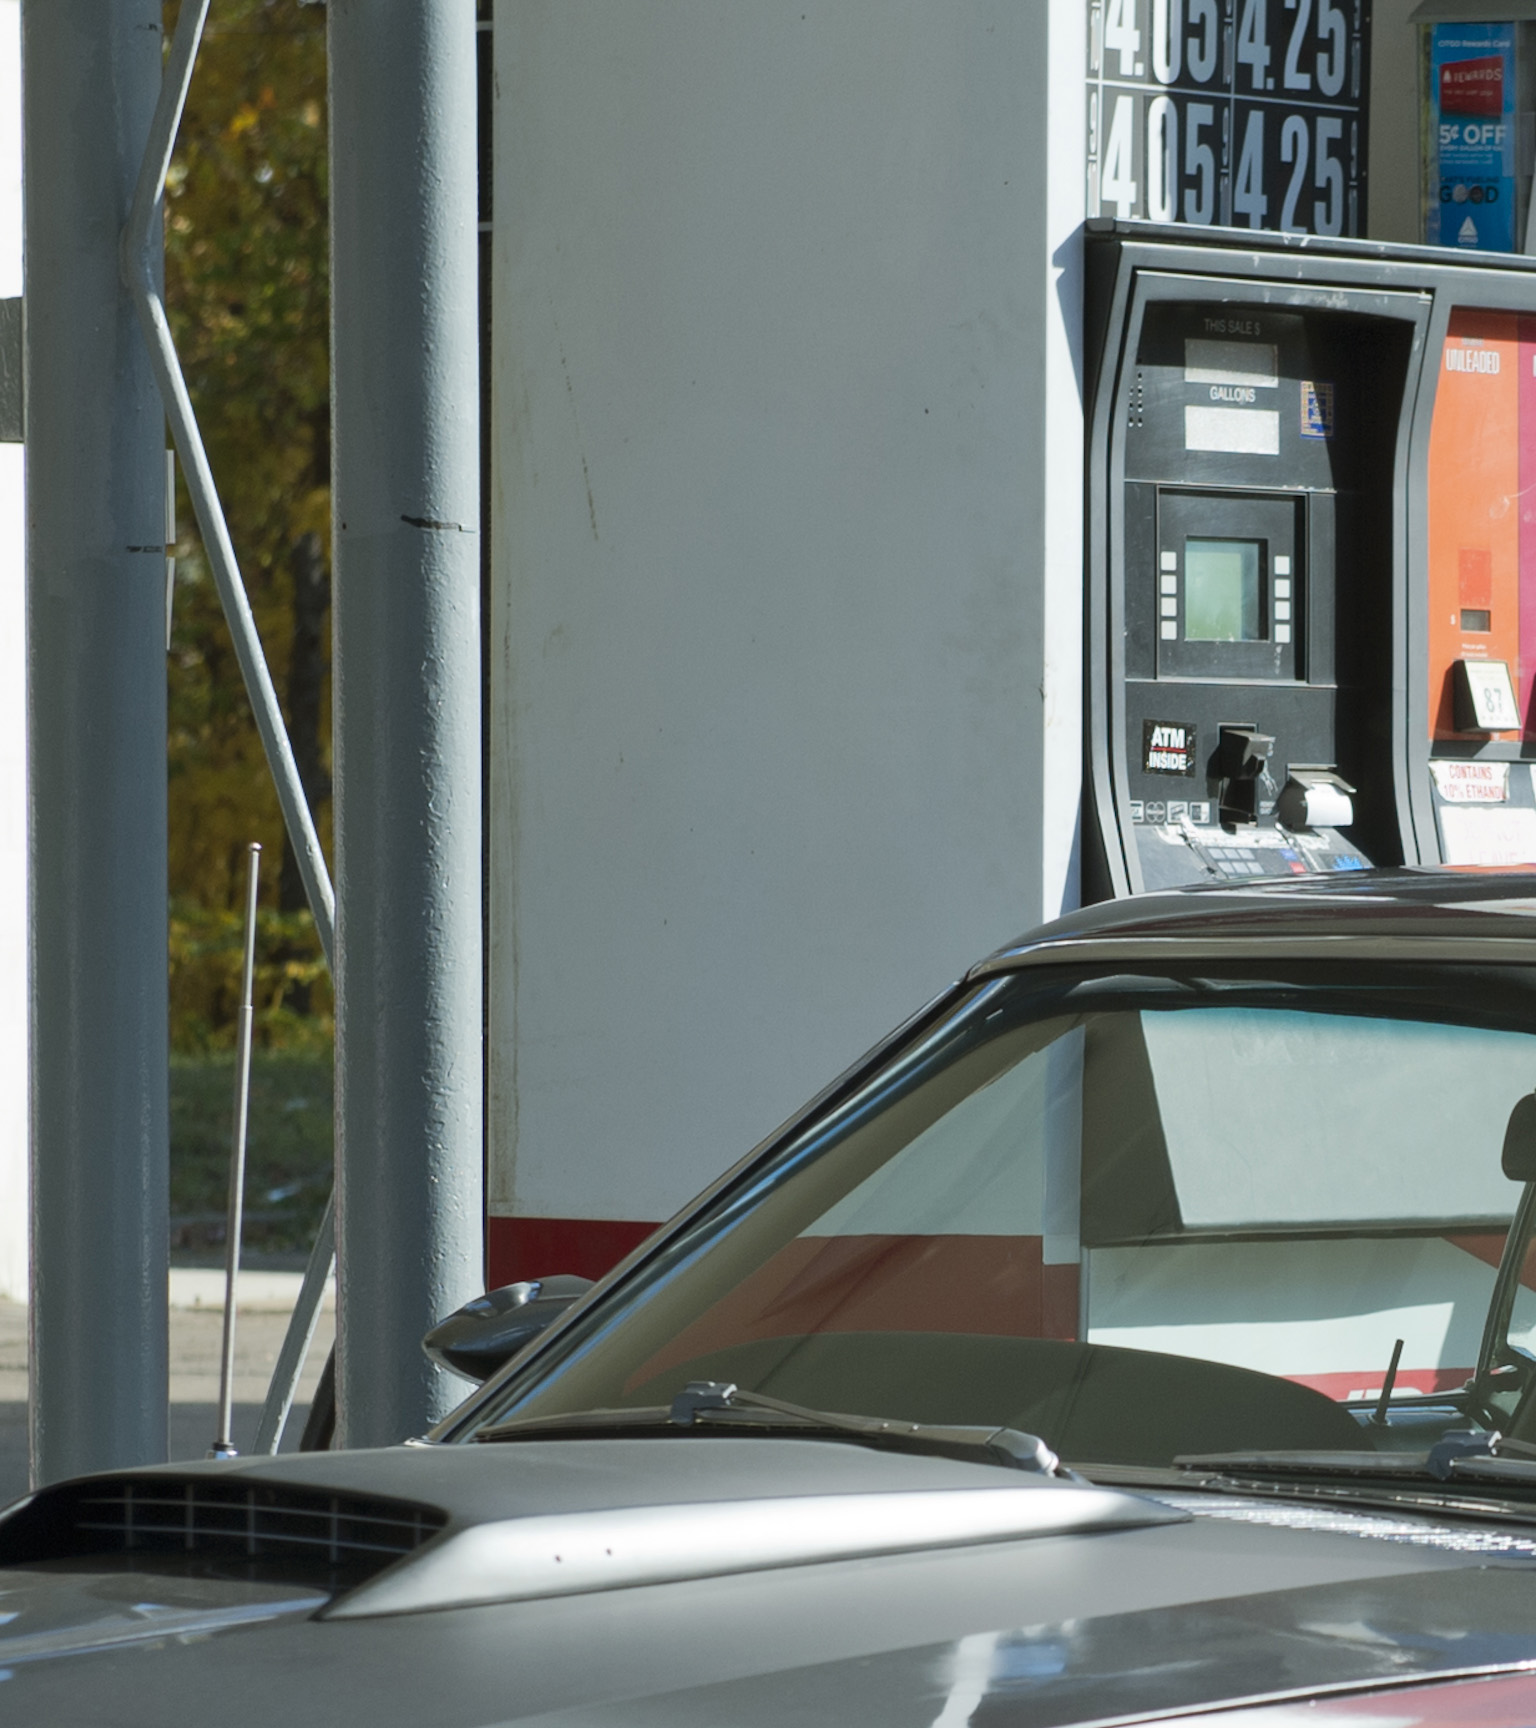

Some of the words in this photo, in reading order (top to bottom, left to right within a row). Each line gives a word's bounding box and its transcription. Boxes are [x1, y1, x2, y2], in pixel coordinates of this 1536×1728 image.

[1463, 123, 1507, 145] OFF
[1102, 96, 1214, 225] 405
[1234, 110, 1343, 237] 425
[1204, 318, 1227, 333] THIS
[1228, 320, 1252, 335] SALE
[1446, 349, 1500, 374] UNLEADED
[1210, 386, 1256, 403] GALLONS
[1484, 687, 1503, 714] 87
[1151, 725, 1186, 749] ATM
[1148, 751, 1188, 771] INSIDE
[1449, 764, 1492, 780] CONTAINS
